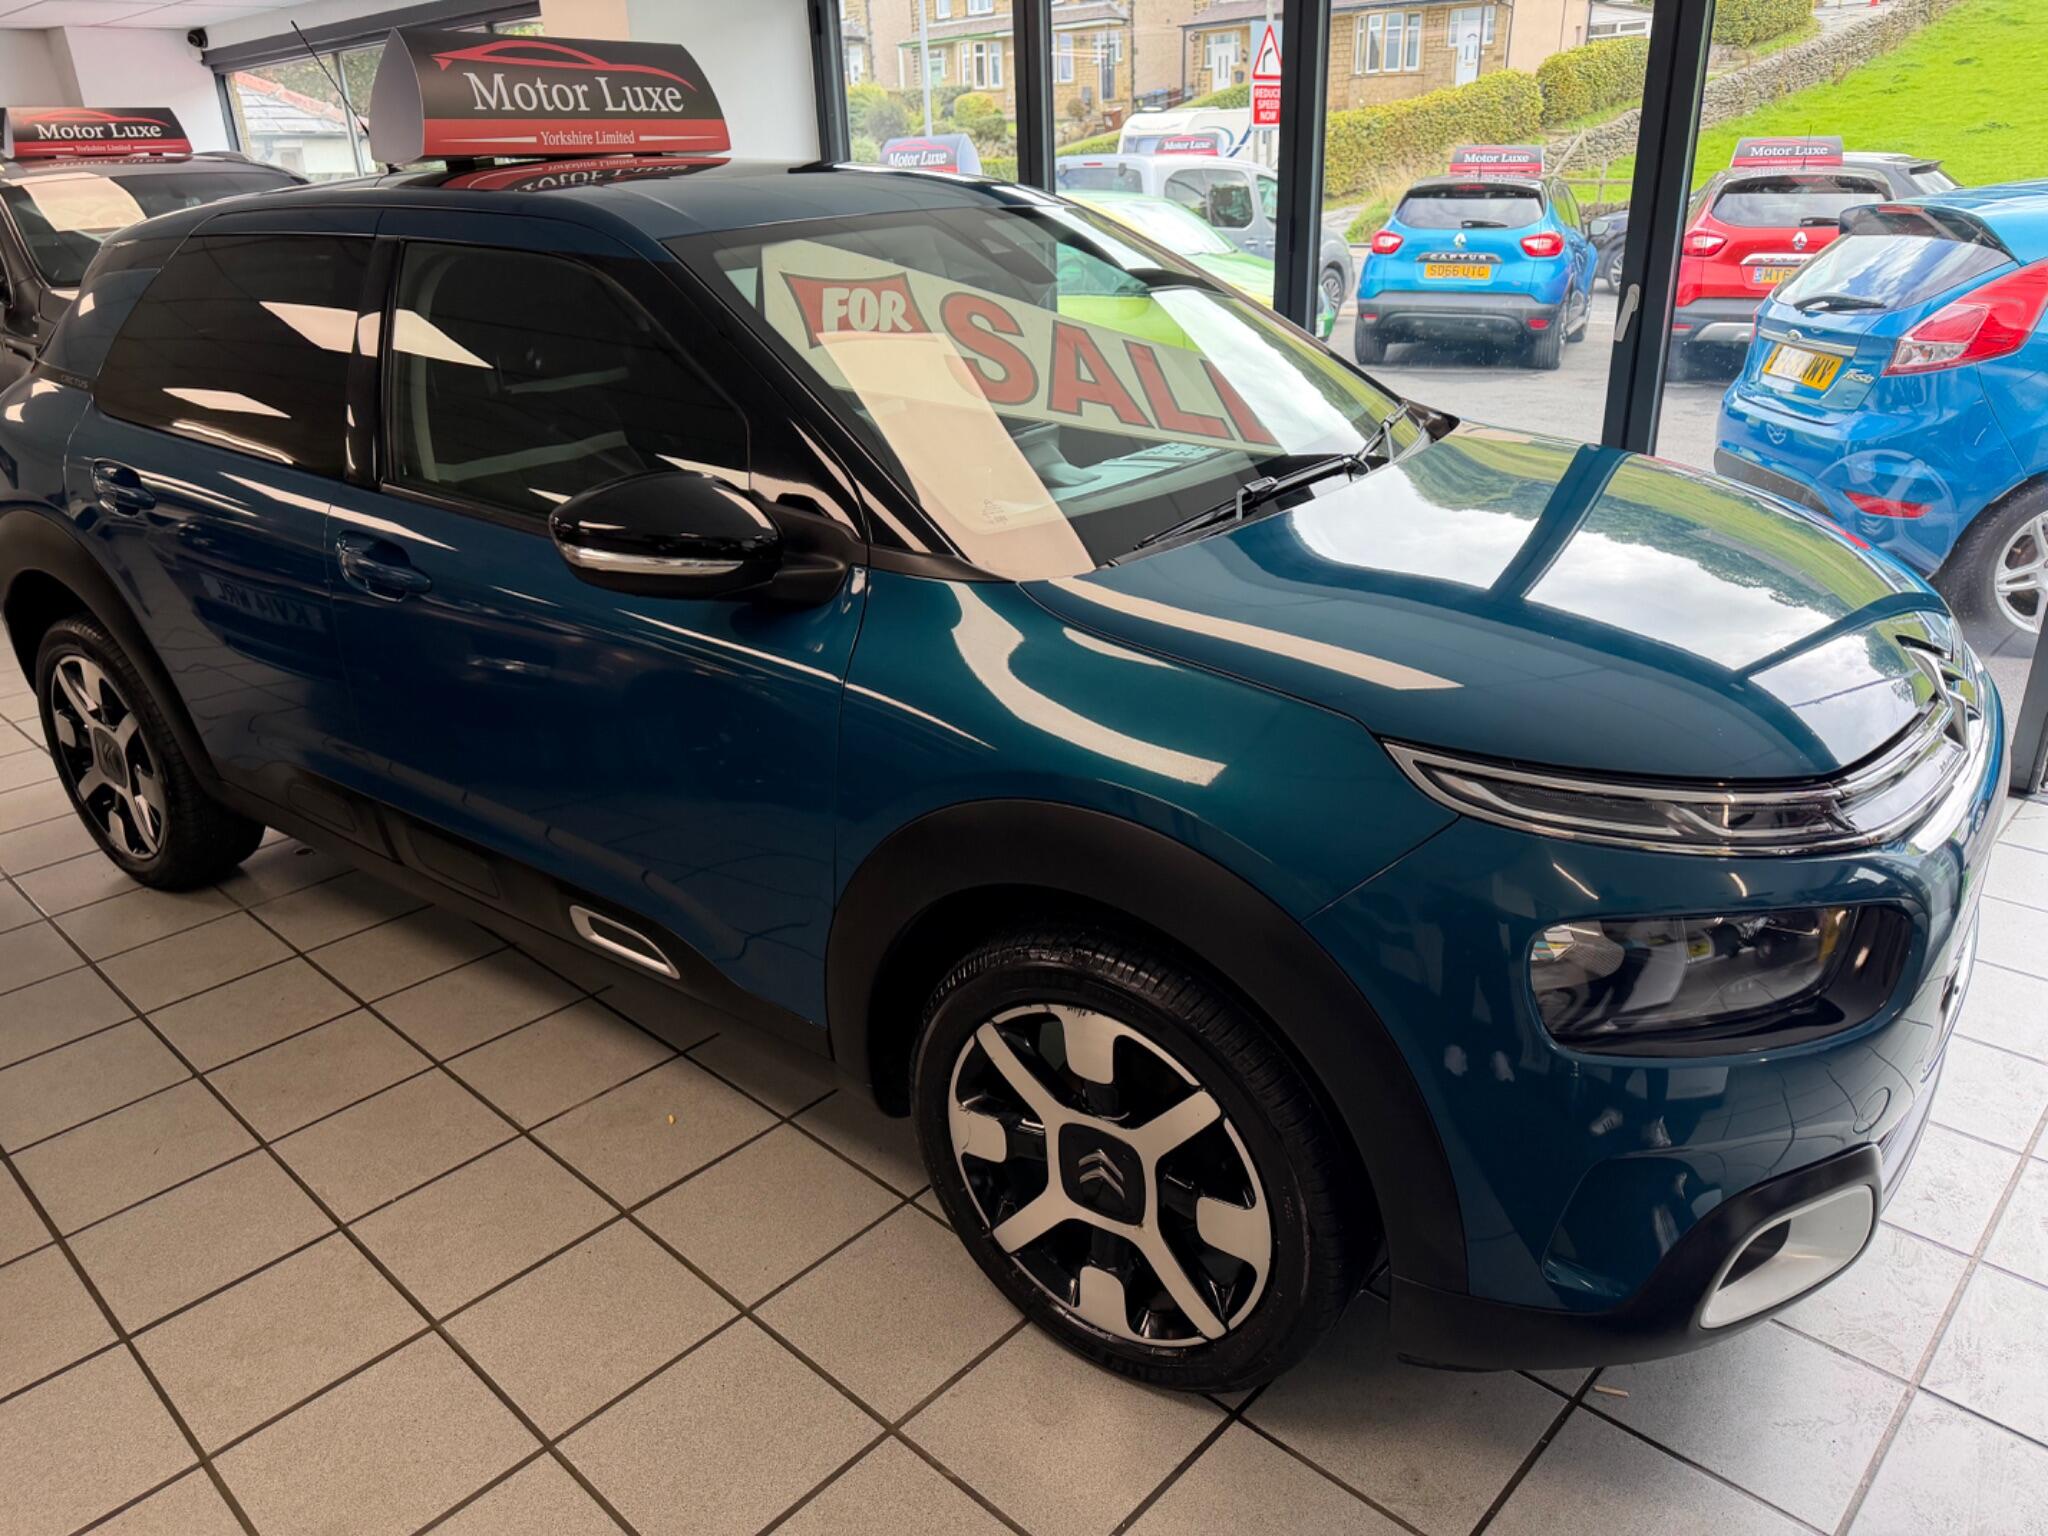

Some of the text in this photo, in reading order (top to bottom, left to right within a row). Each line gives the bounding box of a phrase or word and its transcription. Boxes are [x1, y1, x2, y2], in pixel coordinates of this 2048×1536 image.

[463, 72, 684, 113] Motor Luxe
[1255, 87, 1280, 99] REDUC
[1257, 99, 1280, 109] SPEED
[1260, 110, 1277, 120] NOW
[35, 122, 163, 139] Motor Luxe
[540, 131, 636, 146] Yorkshire Limited
[1163, 141, 1211, 150] Motor Luxe
[1750, 145, 1829, 157] Motor Luxe
[888, 150, 947, 167] Motor Luxe
[1464, 153, 1530, 164] Motor Luxe
[1430, 265, 1460, 277] SD66
[821, 287, 912, 333] FOR
